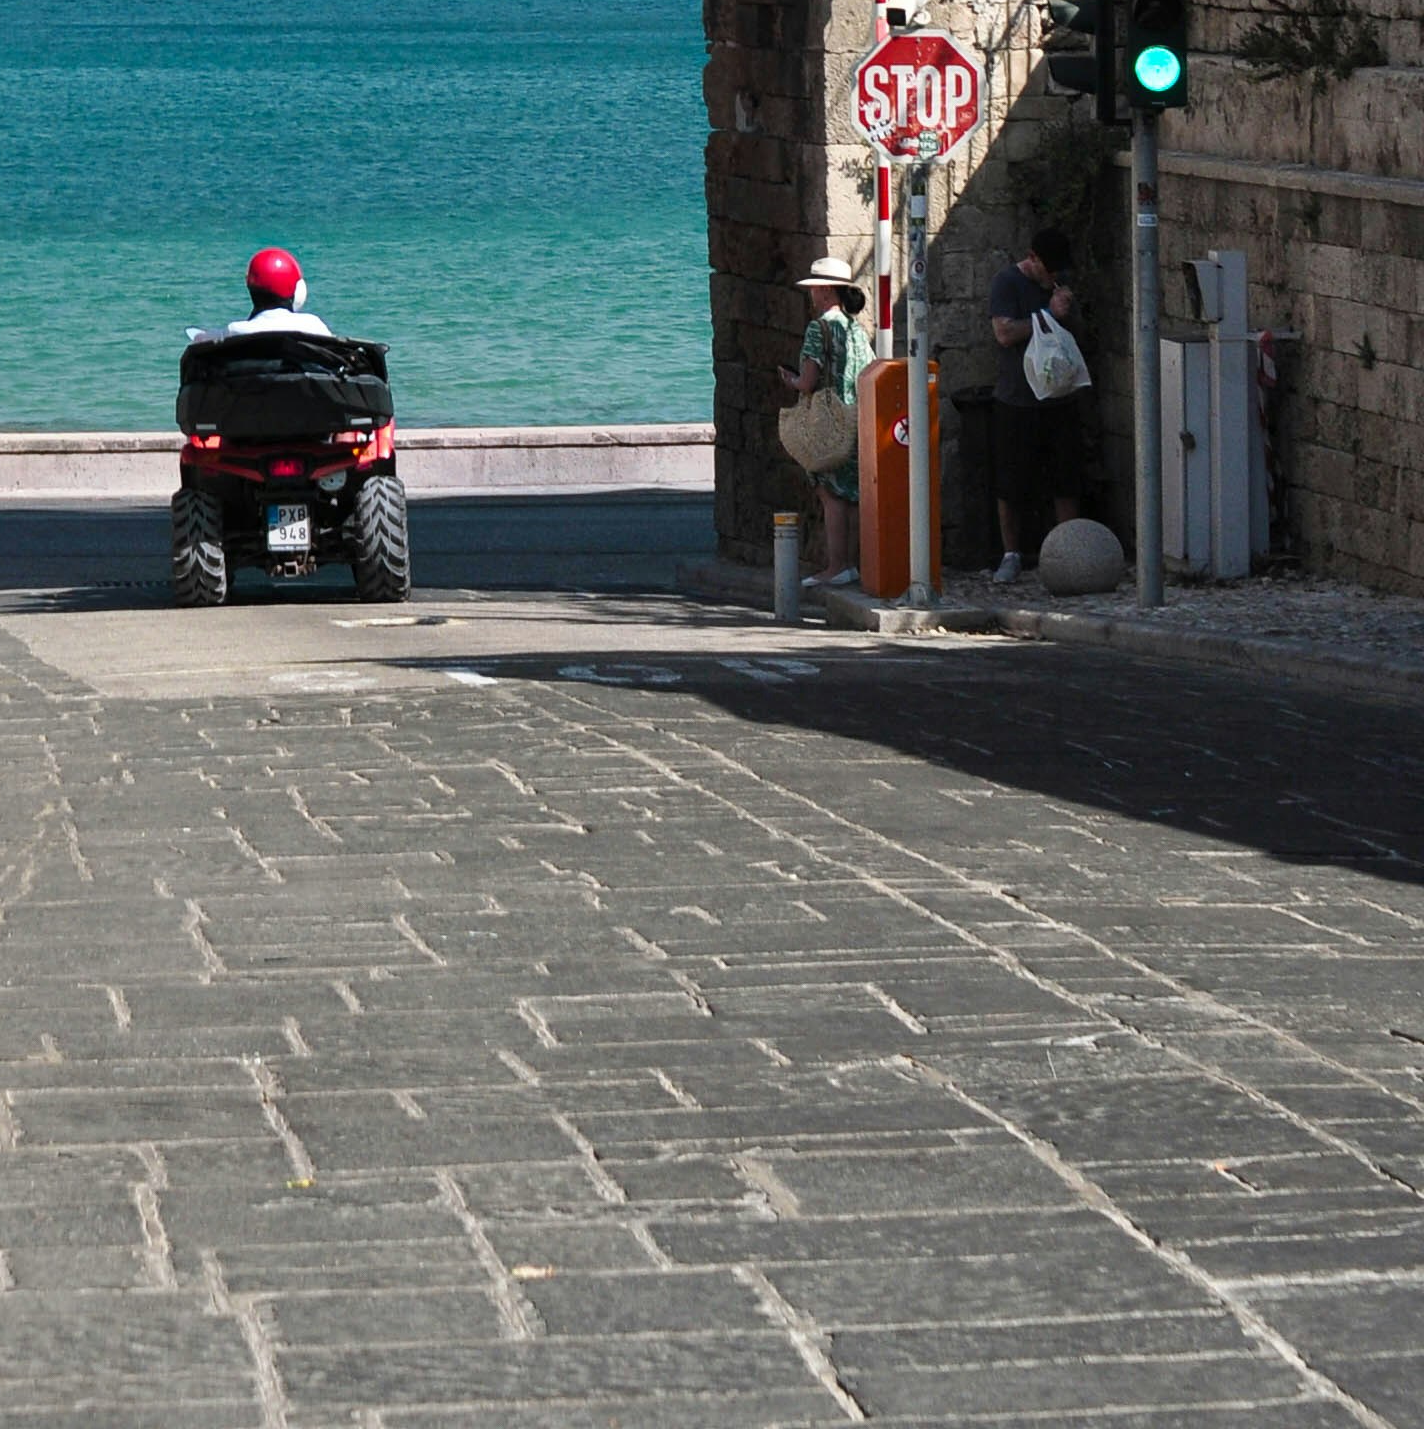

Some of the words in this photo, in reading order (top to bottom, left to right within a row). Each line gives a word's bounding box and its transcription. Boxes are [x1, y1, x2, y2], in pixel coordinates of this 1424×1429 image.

[864, 64, 973, 129] STOP
[278, 508, 306, 522] PXB
[279, 526, 306, 540] 948
